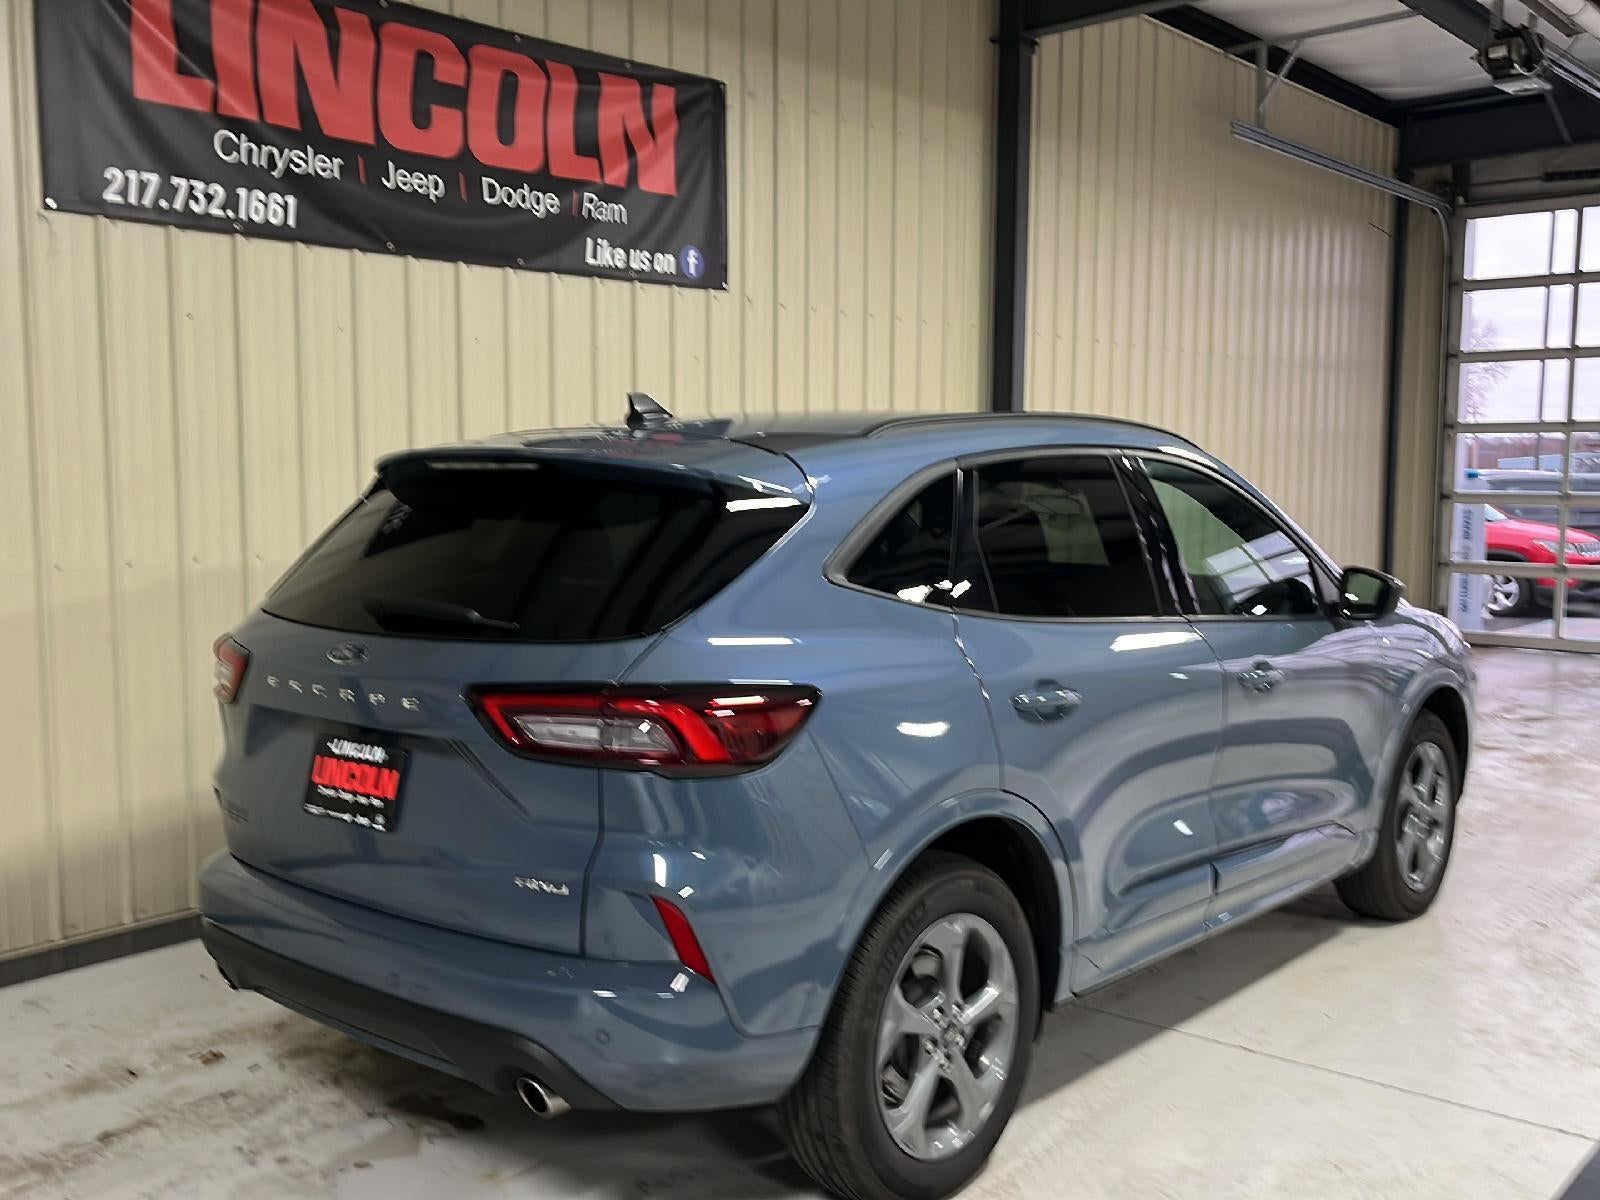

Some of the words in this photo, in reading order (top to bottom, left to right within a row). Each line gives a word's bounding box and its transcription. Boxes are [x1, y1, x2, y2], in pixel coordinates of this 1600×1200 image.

[131, 0, 679, 197] LINCOLN
[102, 166, 298, 229] 217.732.1661
[213, 129, 344, 180] Chrysler
[381, 160, 445, 203] Jeep
[481, 176, 561, 219] Dodge
[582, 192, 628, 225] Ram
[584, 236, 628, 271] Like
[629, 247, 652, 273] us
[652, 250, 678, 275] on
